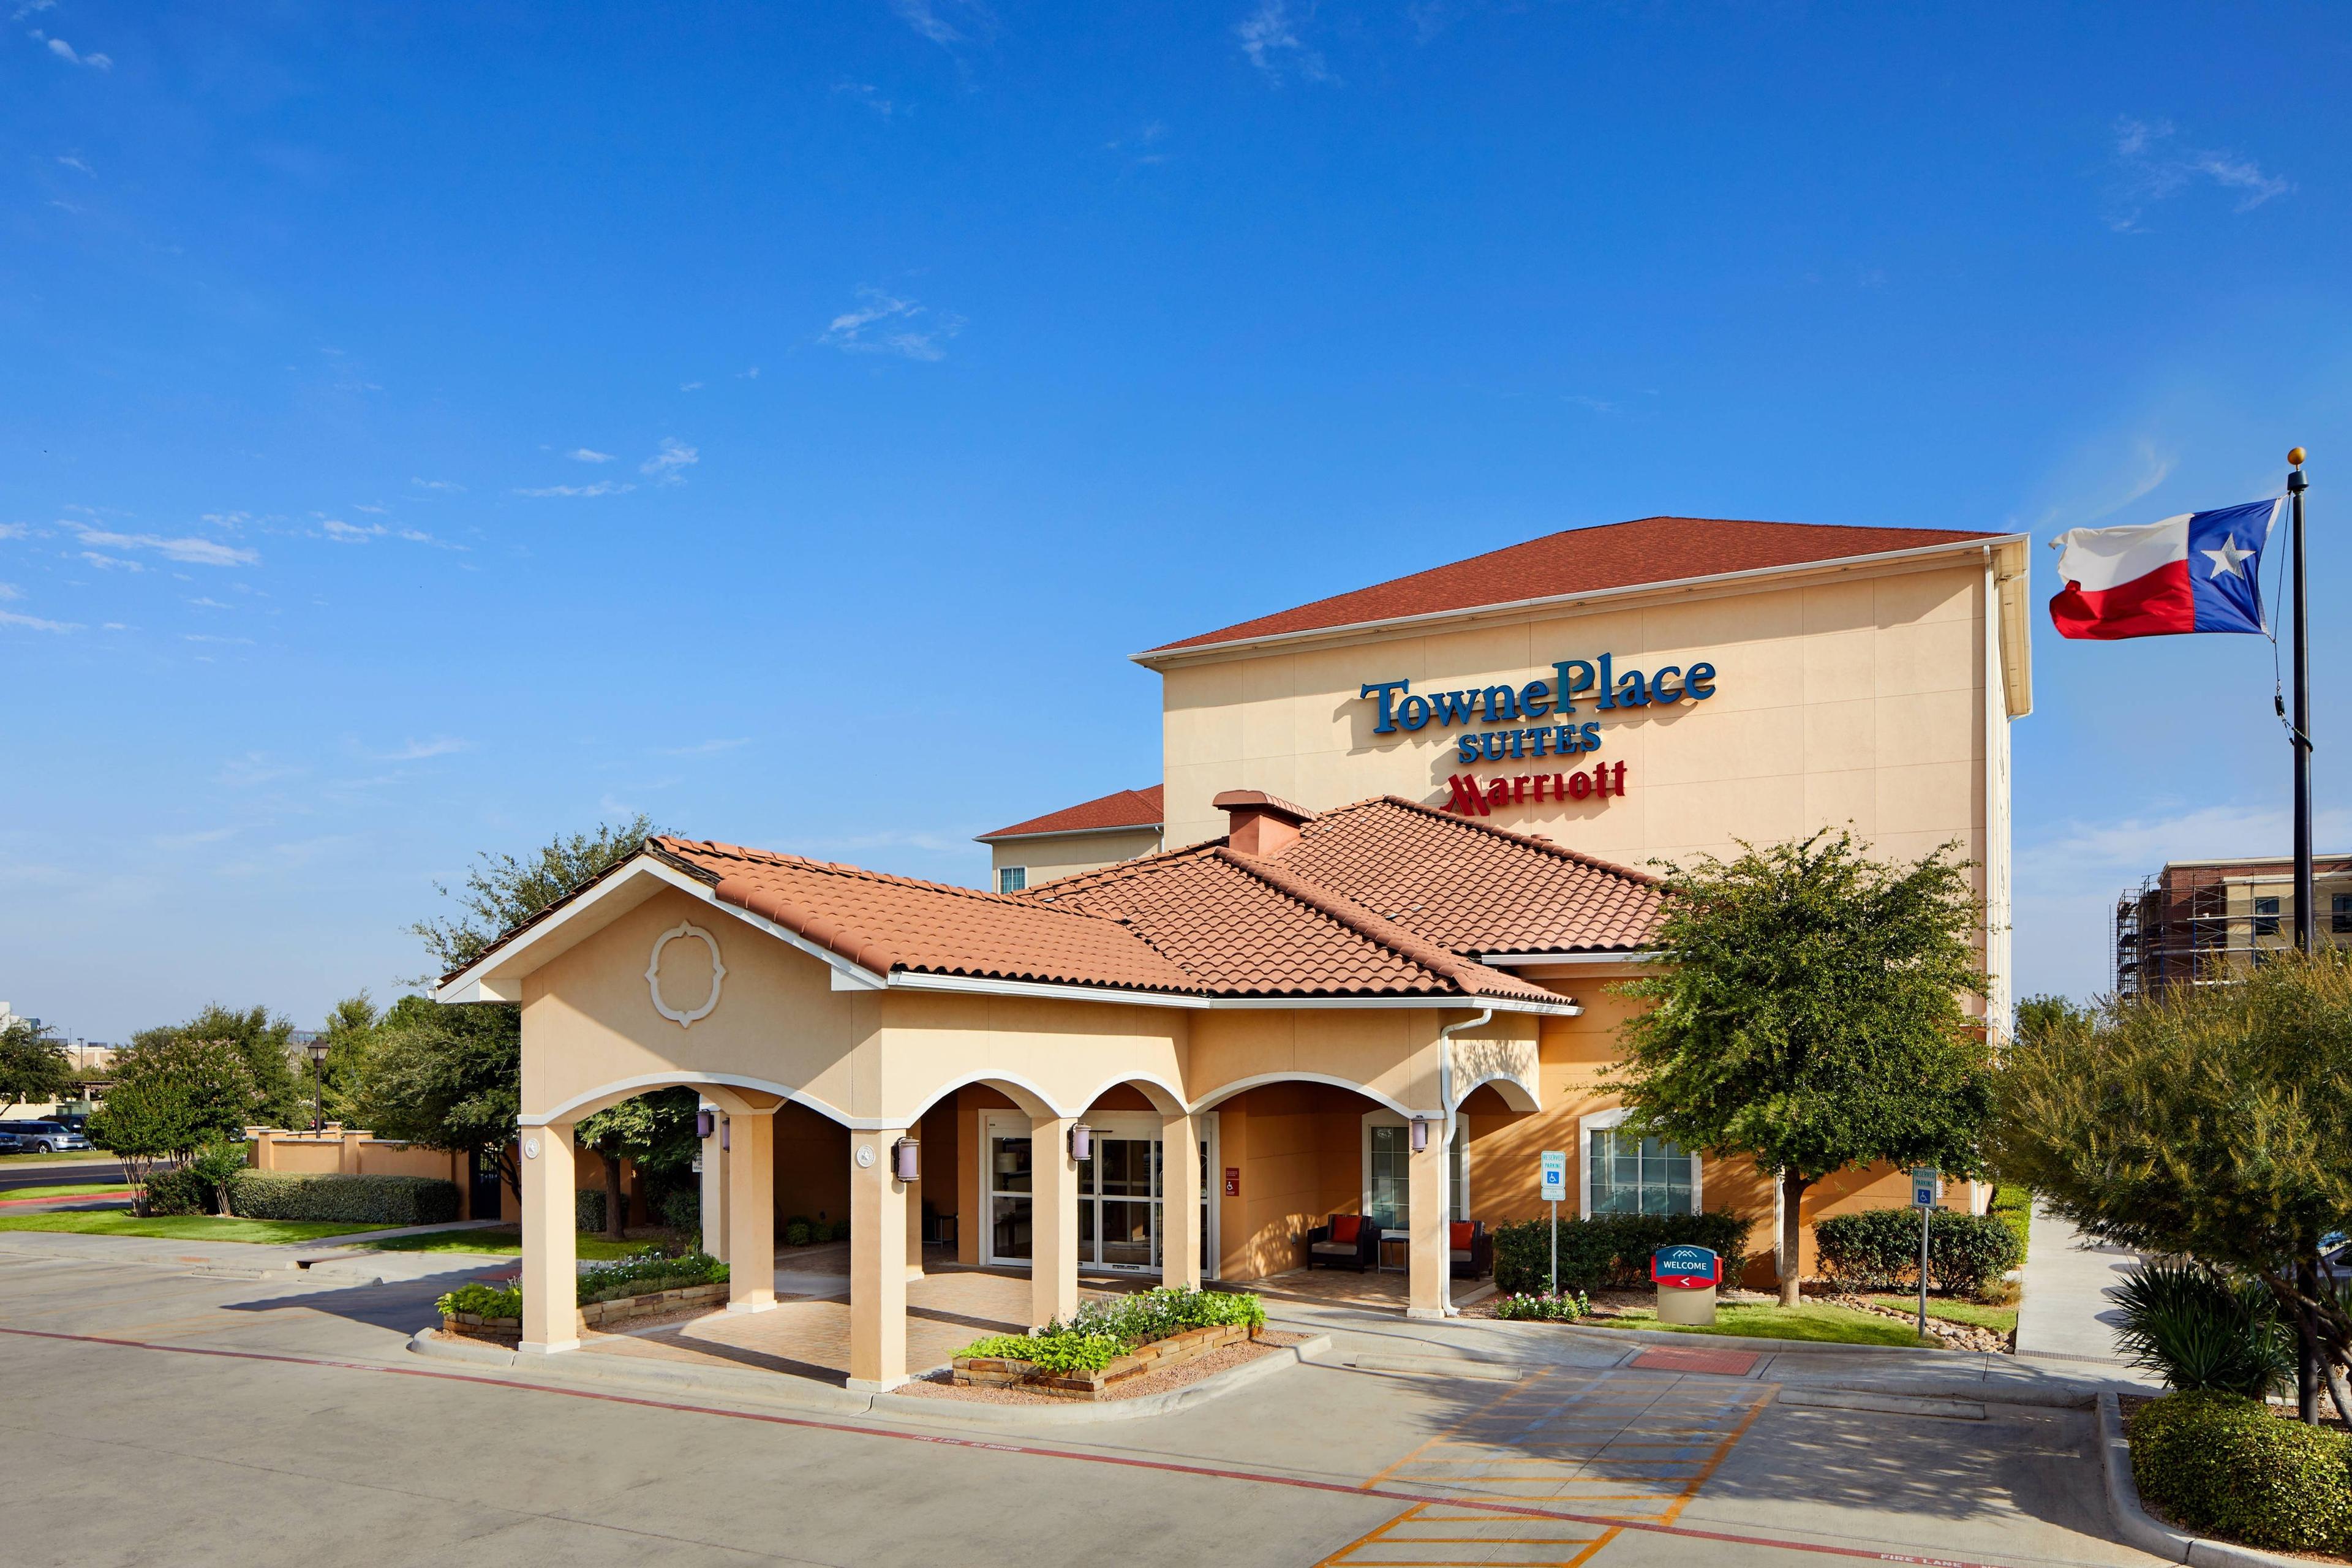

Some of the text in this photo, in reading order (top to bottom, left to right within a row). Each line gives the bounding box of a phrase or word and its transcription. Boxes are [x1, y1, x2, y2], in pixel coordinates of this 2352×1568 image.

[1360, 652, 1716, 734] TownePlace
[1459, 722, 1602, 763] SUITES
[1440, 760, 1627, 816] Marriott
[1664, 1261, 1706, 1270] WELCOME
[1923, 1558, 1962, 1567] LANE
